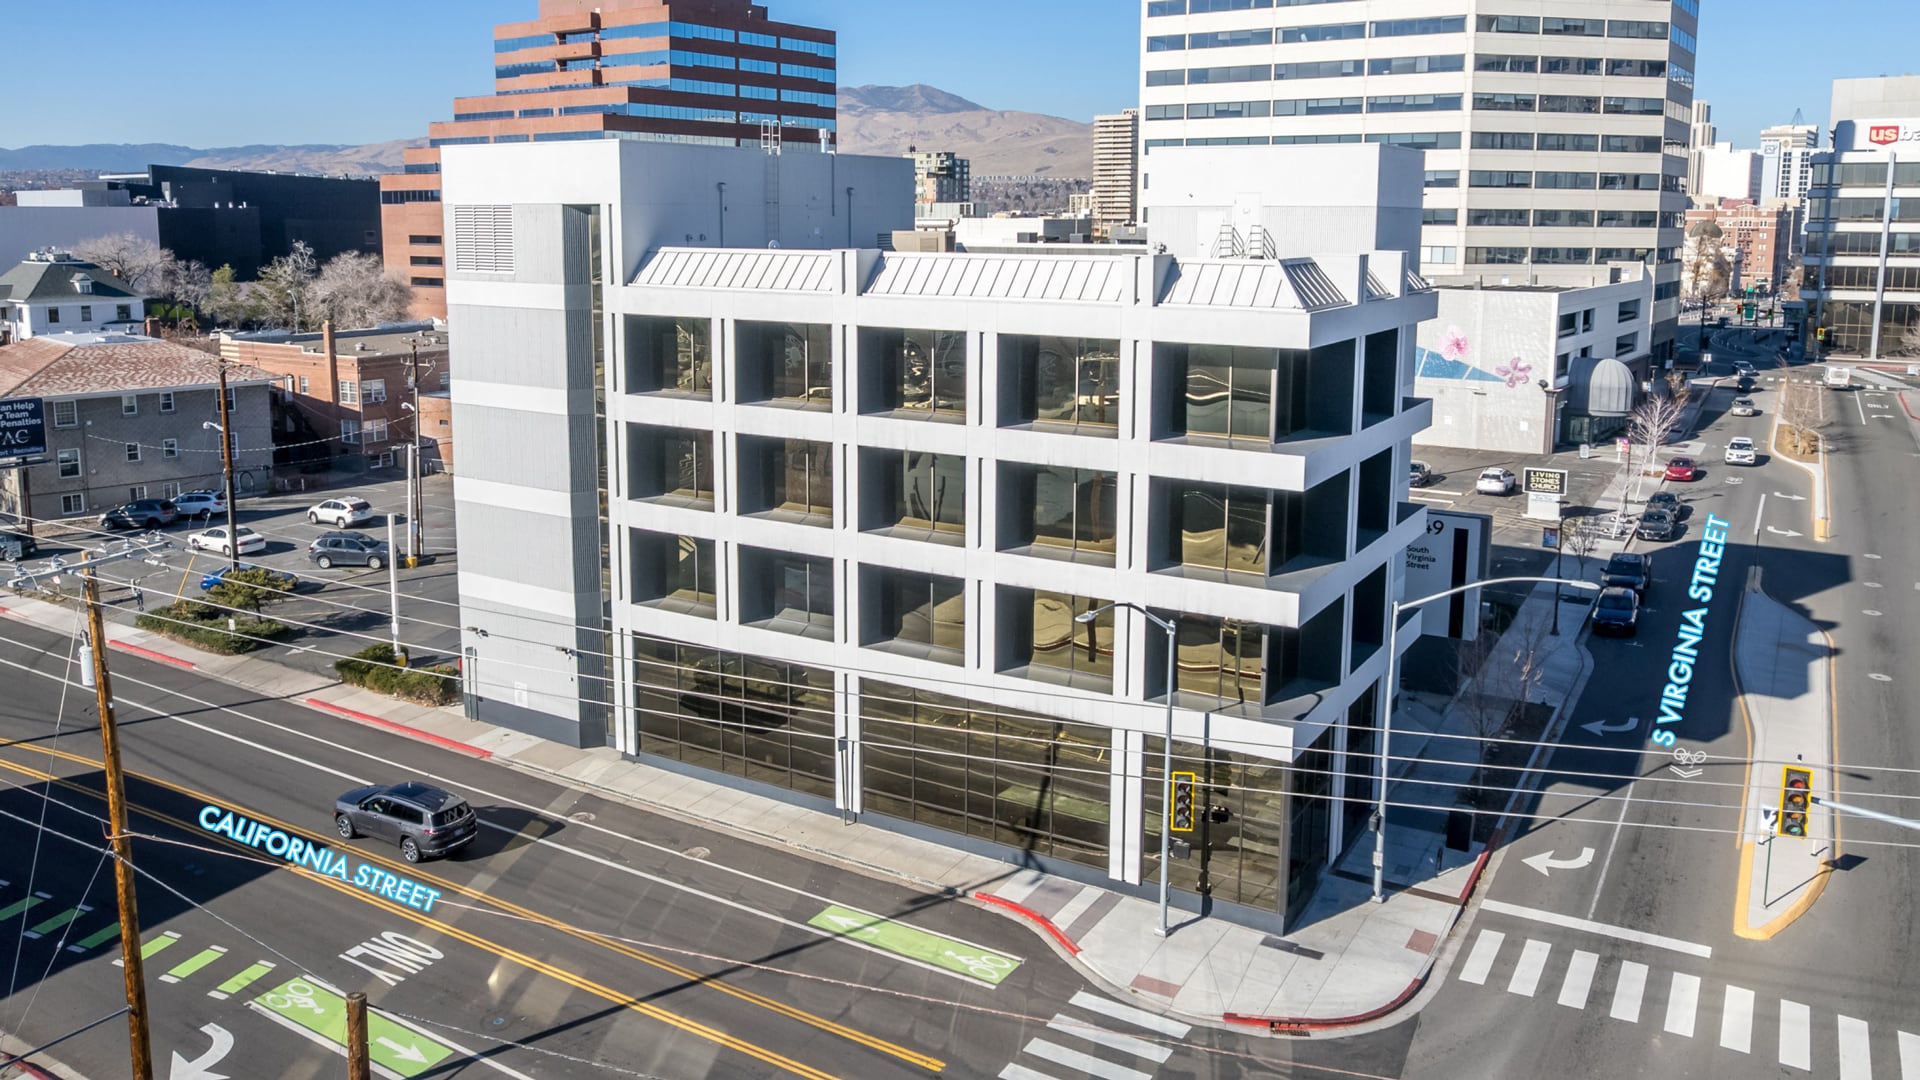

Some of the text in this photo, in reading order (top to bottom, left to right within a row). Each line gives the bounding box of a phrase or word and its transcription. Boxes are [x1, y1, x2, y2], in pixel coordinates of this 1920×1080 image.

[1870, 129, 1897, 142] us
[0, 402, 35, 412] an Help
[4, 411, 29, 419] Team
[1, 418, 41, 427] Penalties
[1530, 471, 1560, 479] LIVING
[1530, 477, 1560, 485] STONES
[1530, 483, 1560, 491] CHURCH
[1406, 545, 1430, 554] South
[1406, 553, 1436, 563] Virginia
[1405, 561, 1430, 570] Street
[338, 931, 444, 986] ONLY
